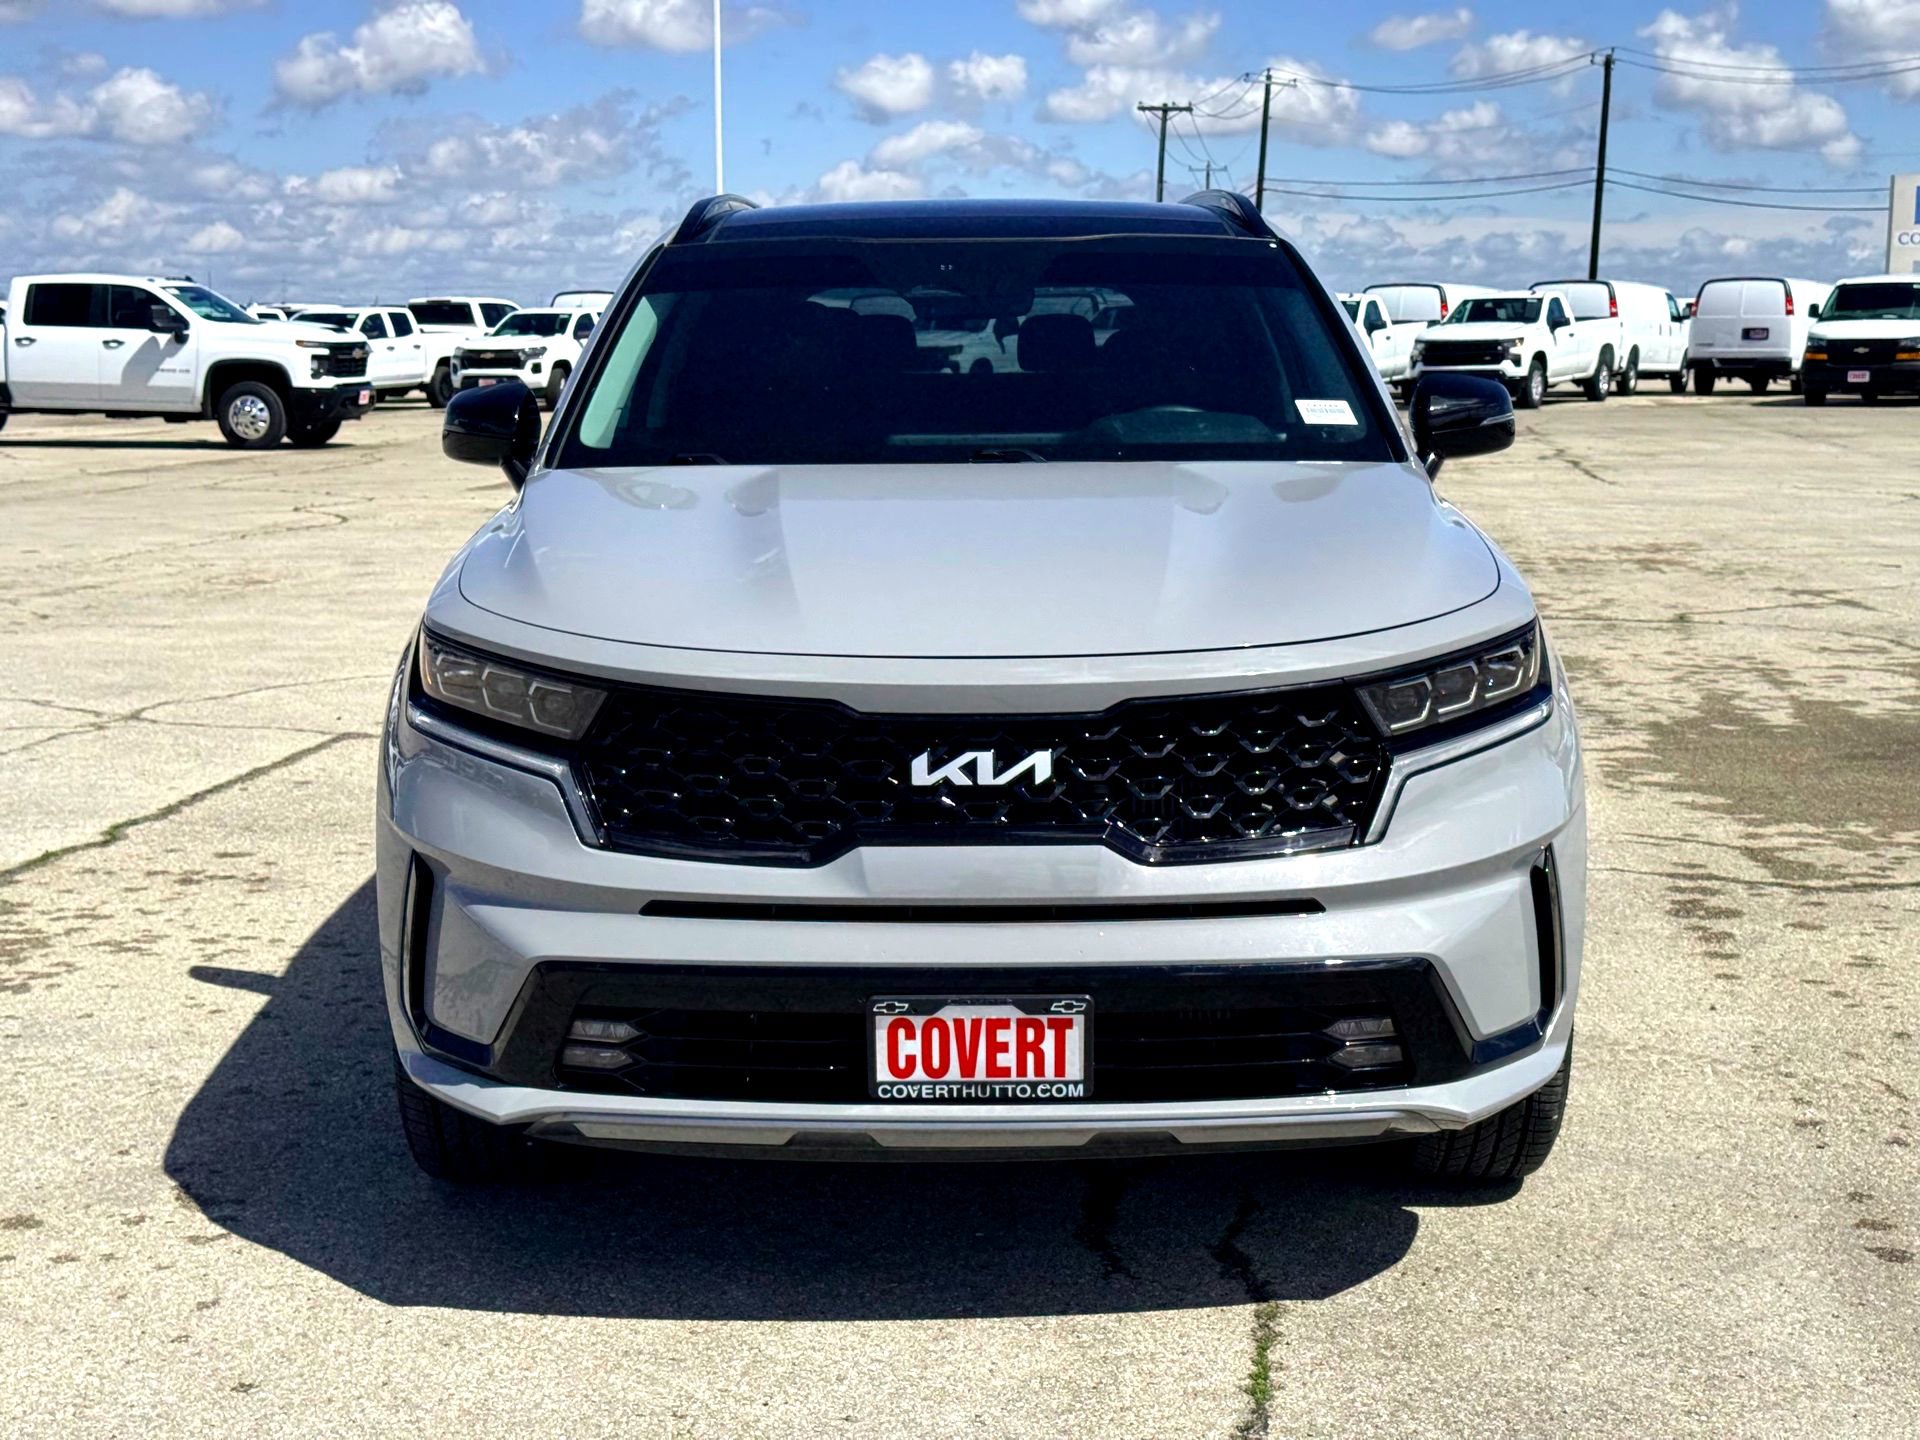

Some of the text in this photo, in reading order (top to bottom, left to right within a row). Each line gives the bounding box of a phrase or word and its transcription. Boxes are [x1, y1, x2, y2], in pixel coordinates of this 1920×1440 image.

[911, 750, 1052, 786] KIA
[886, 1016, 1074, 1080] COVERT
[877, 1083, 1084, 1099] COVERTHUTTO.COM
